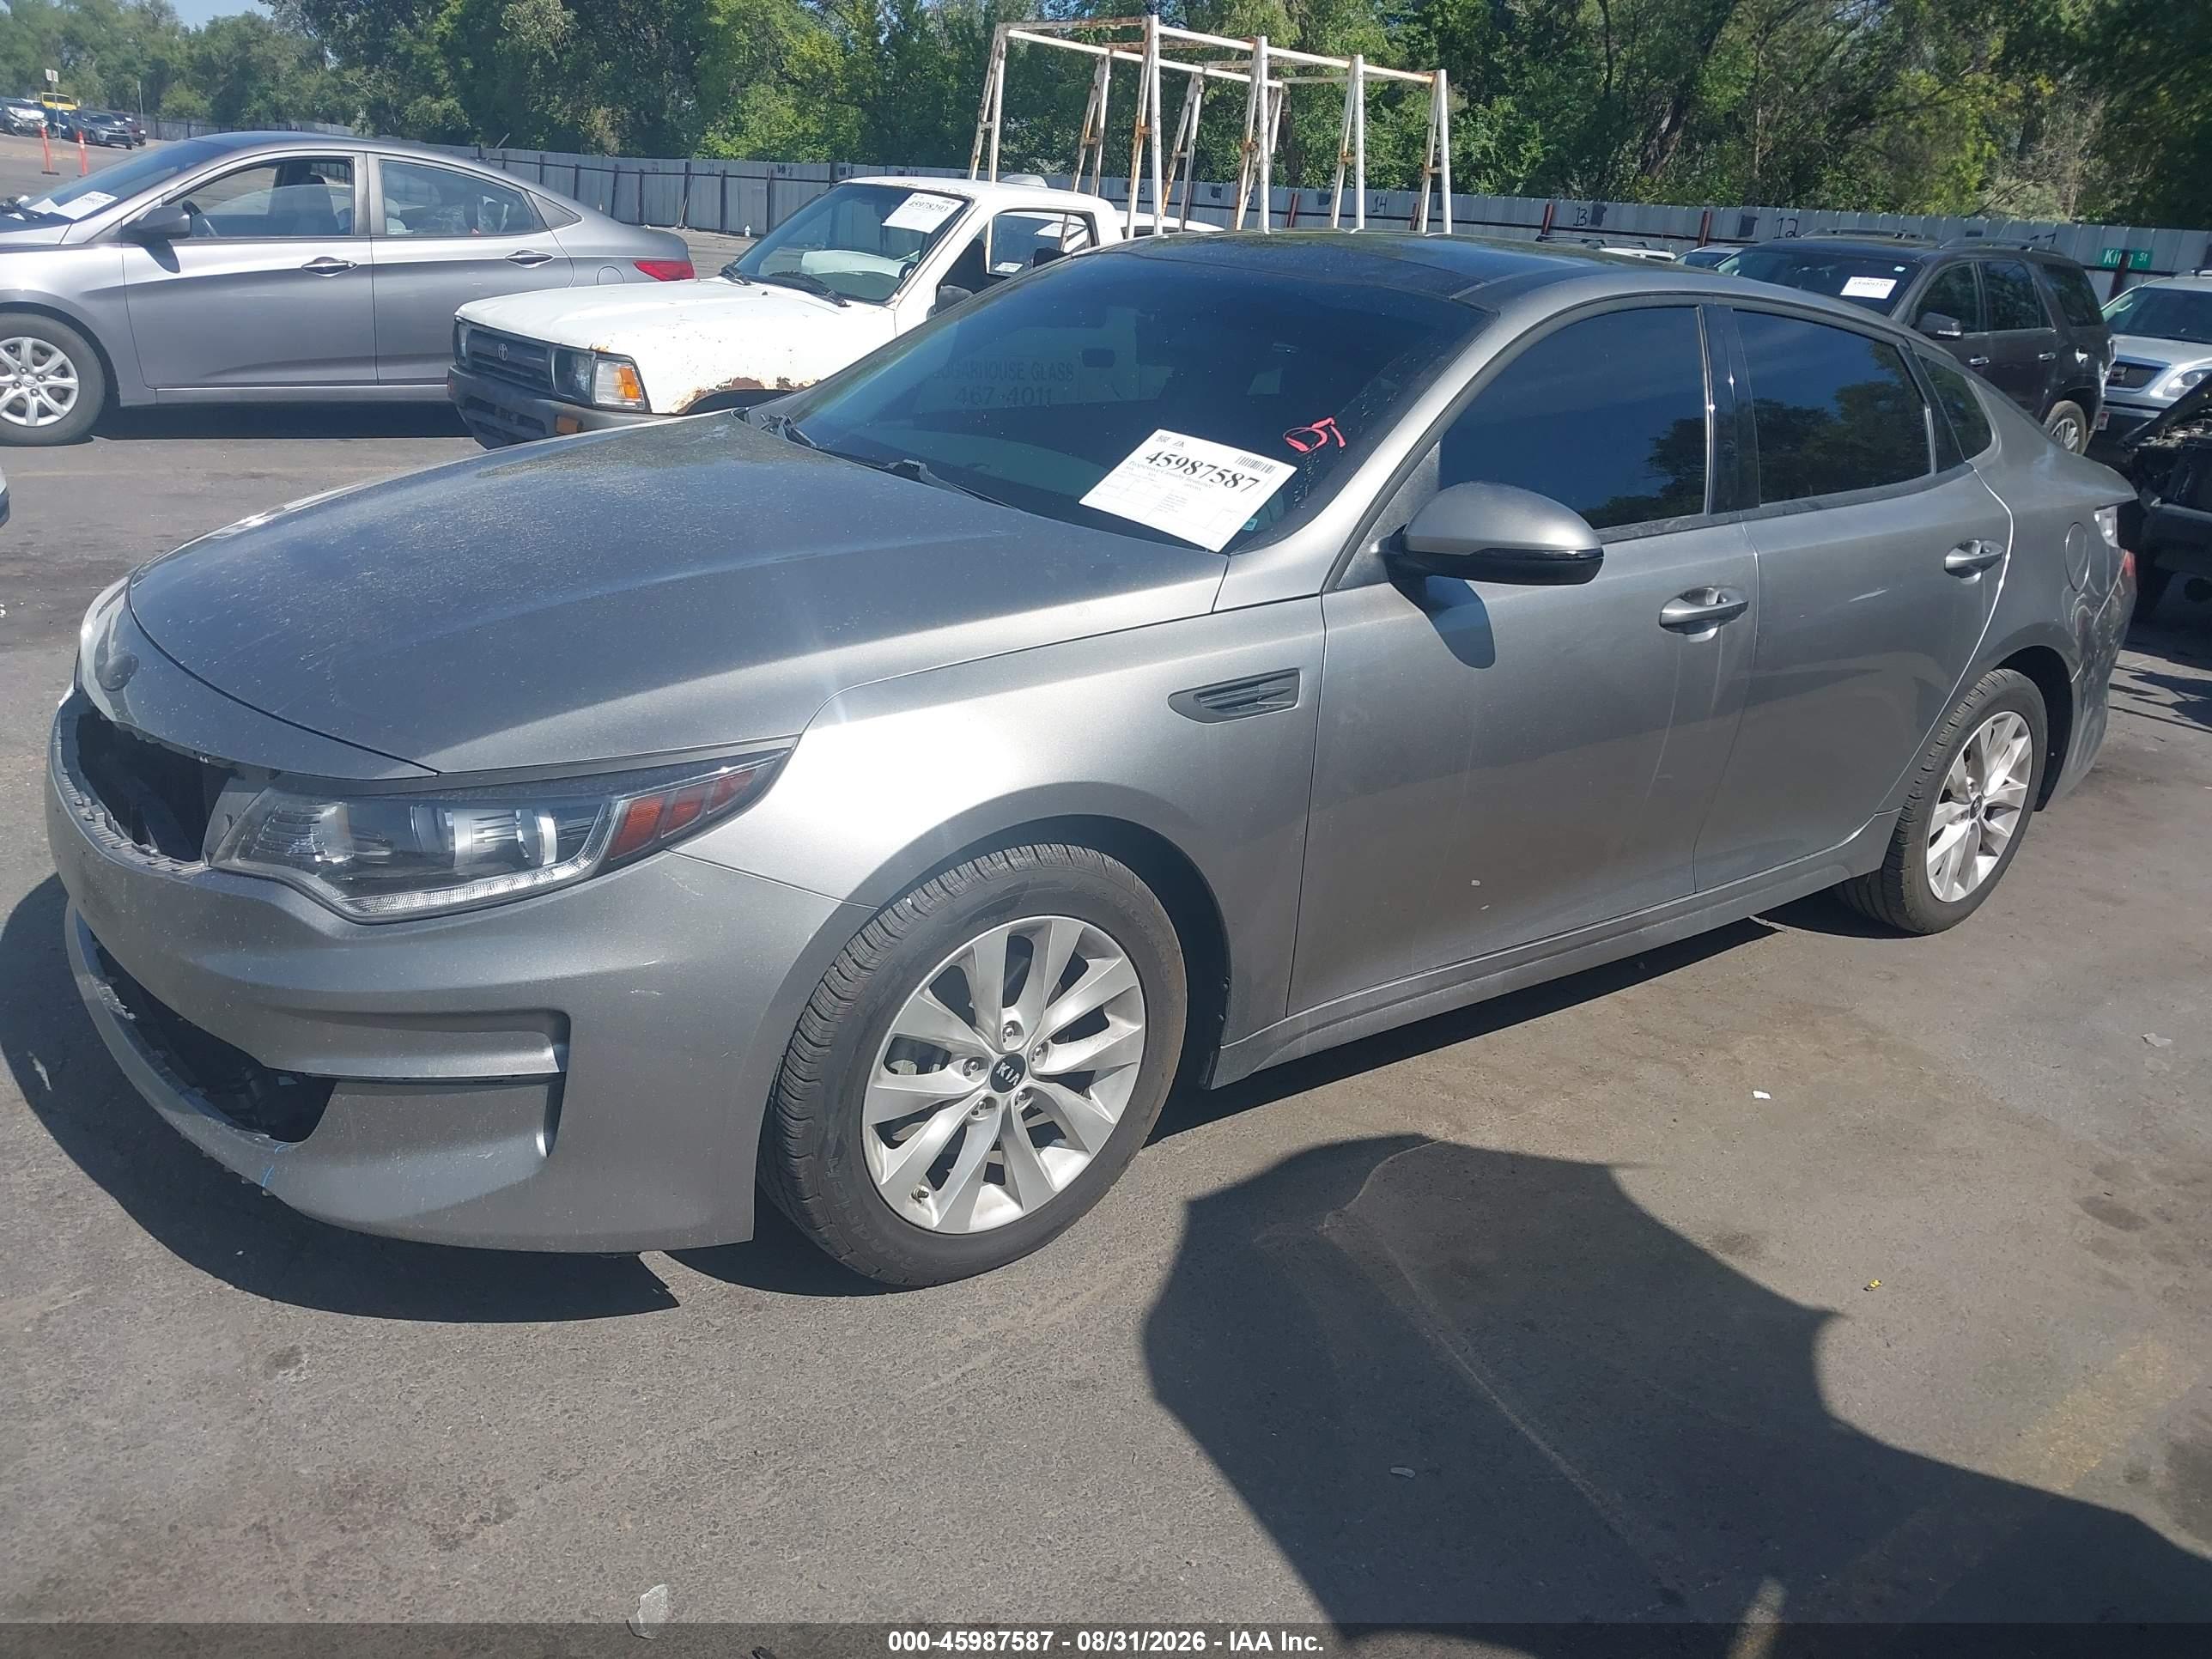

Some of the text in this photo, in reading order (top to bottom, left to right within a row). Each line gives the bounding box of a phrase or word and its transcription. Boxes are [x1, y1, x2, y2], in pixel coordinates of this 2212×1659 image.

[1371, 194, 1388, 214] 14
[1572, 206, 1588, 227] 13
[1772, 216, 1802, 240] 12
[2138, 252, 2148, 262] St
[1030, 361, 1074, 381] GLASS
[1145, 449, 1261, 494] 45987587
[995, 1061, 1020, 1086] KIA
